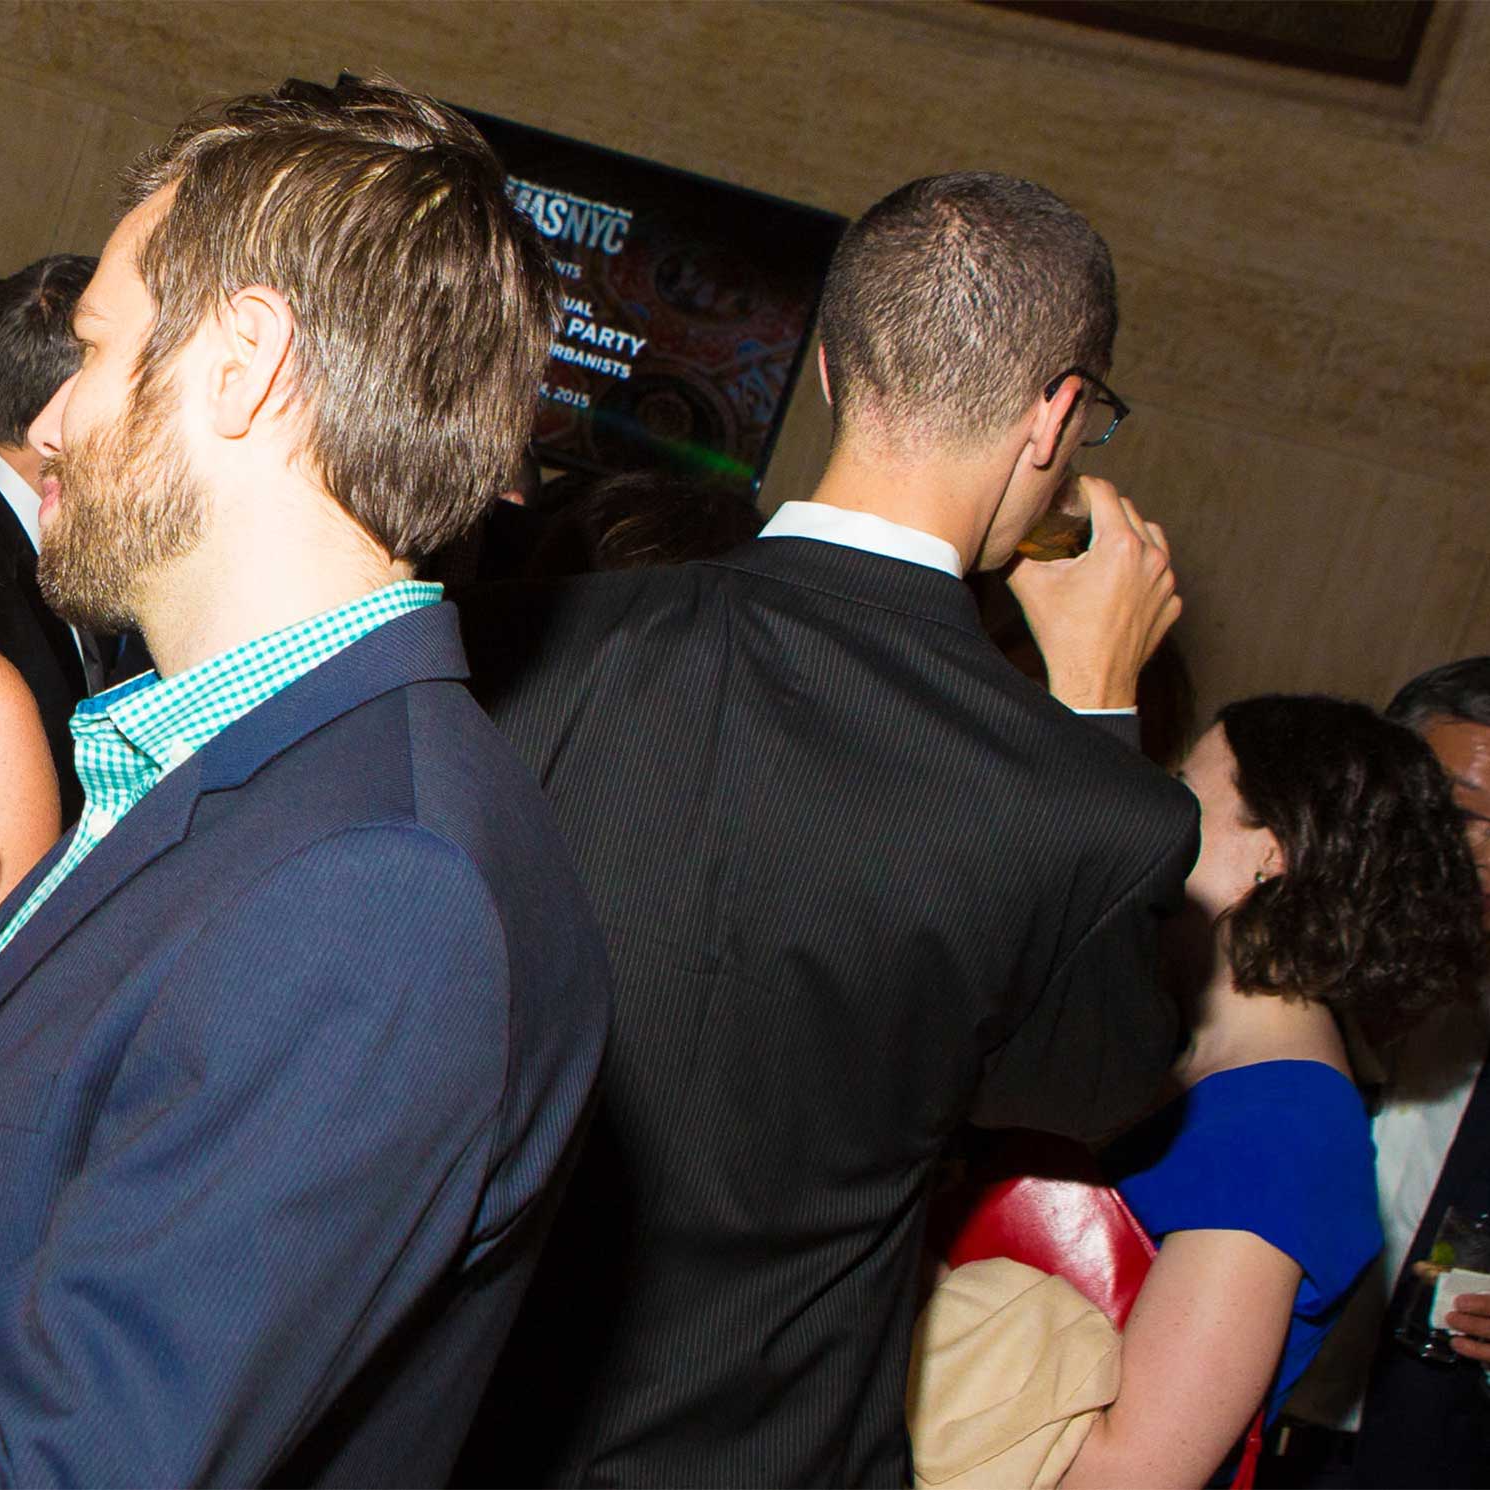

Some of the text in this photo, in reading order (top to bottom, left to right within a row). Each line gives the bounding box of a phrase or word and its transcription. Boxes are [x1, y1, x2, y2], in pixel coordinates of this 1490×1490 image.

[559, 296, 593, 317] UAL
[567, 317, 648, 357] PARTY
[553, 385, 590, 408] 2015
